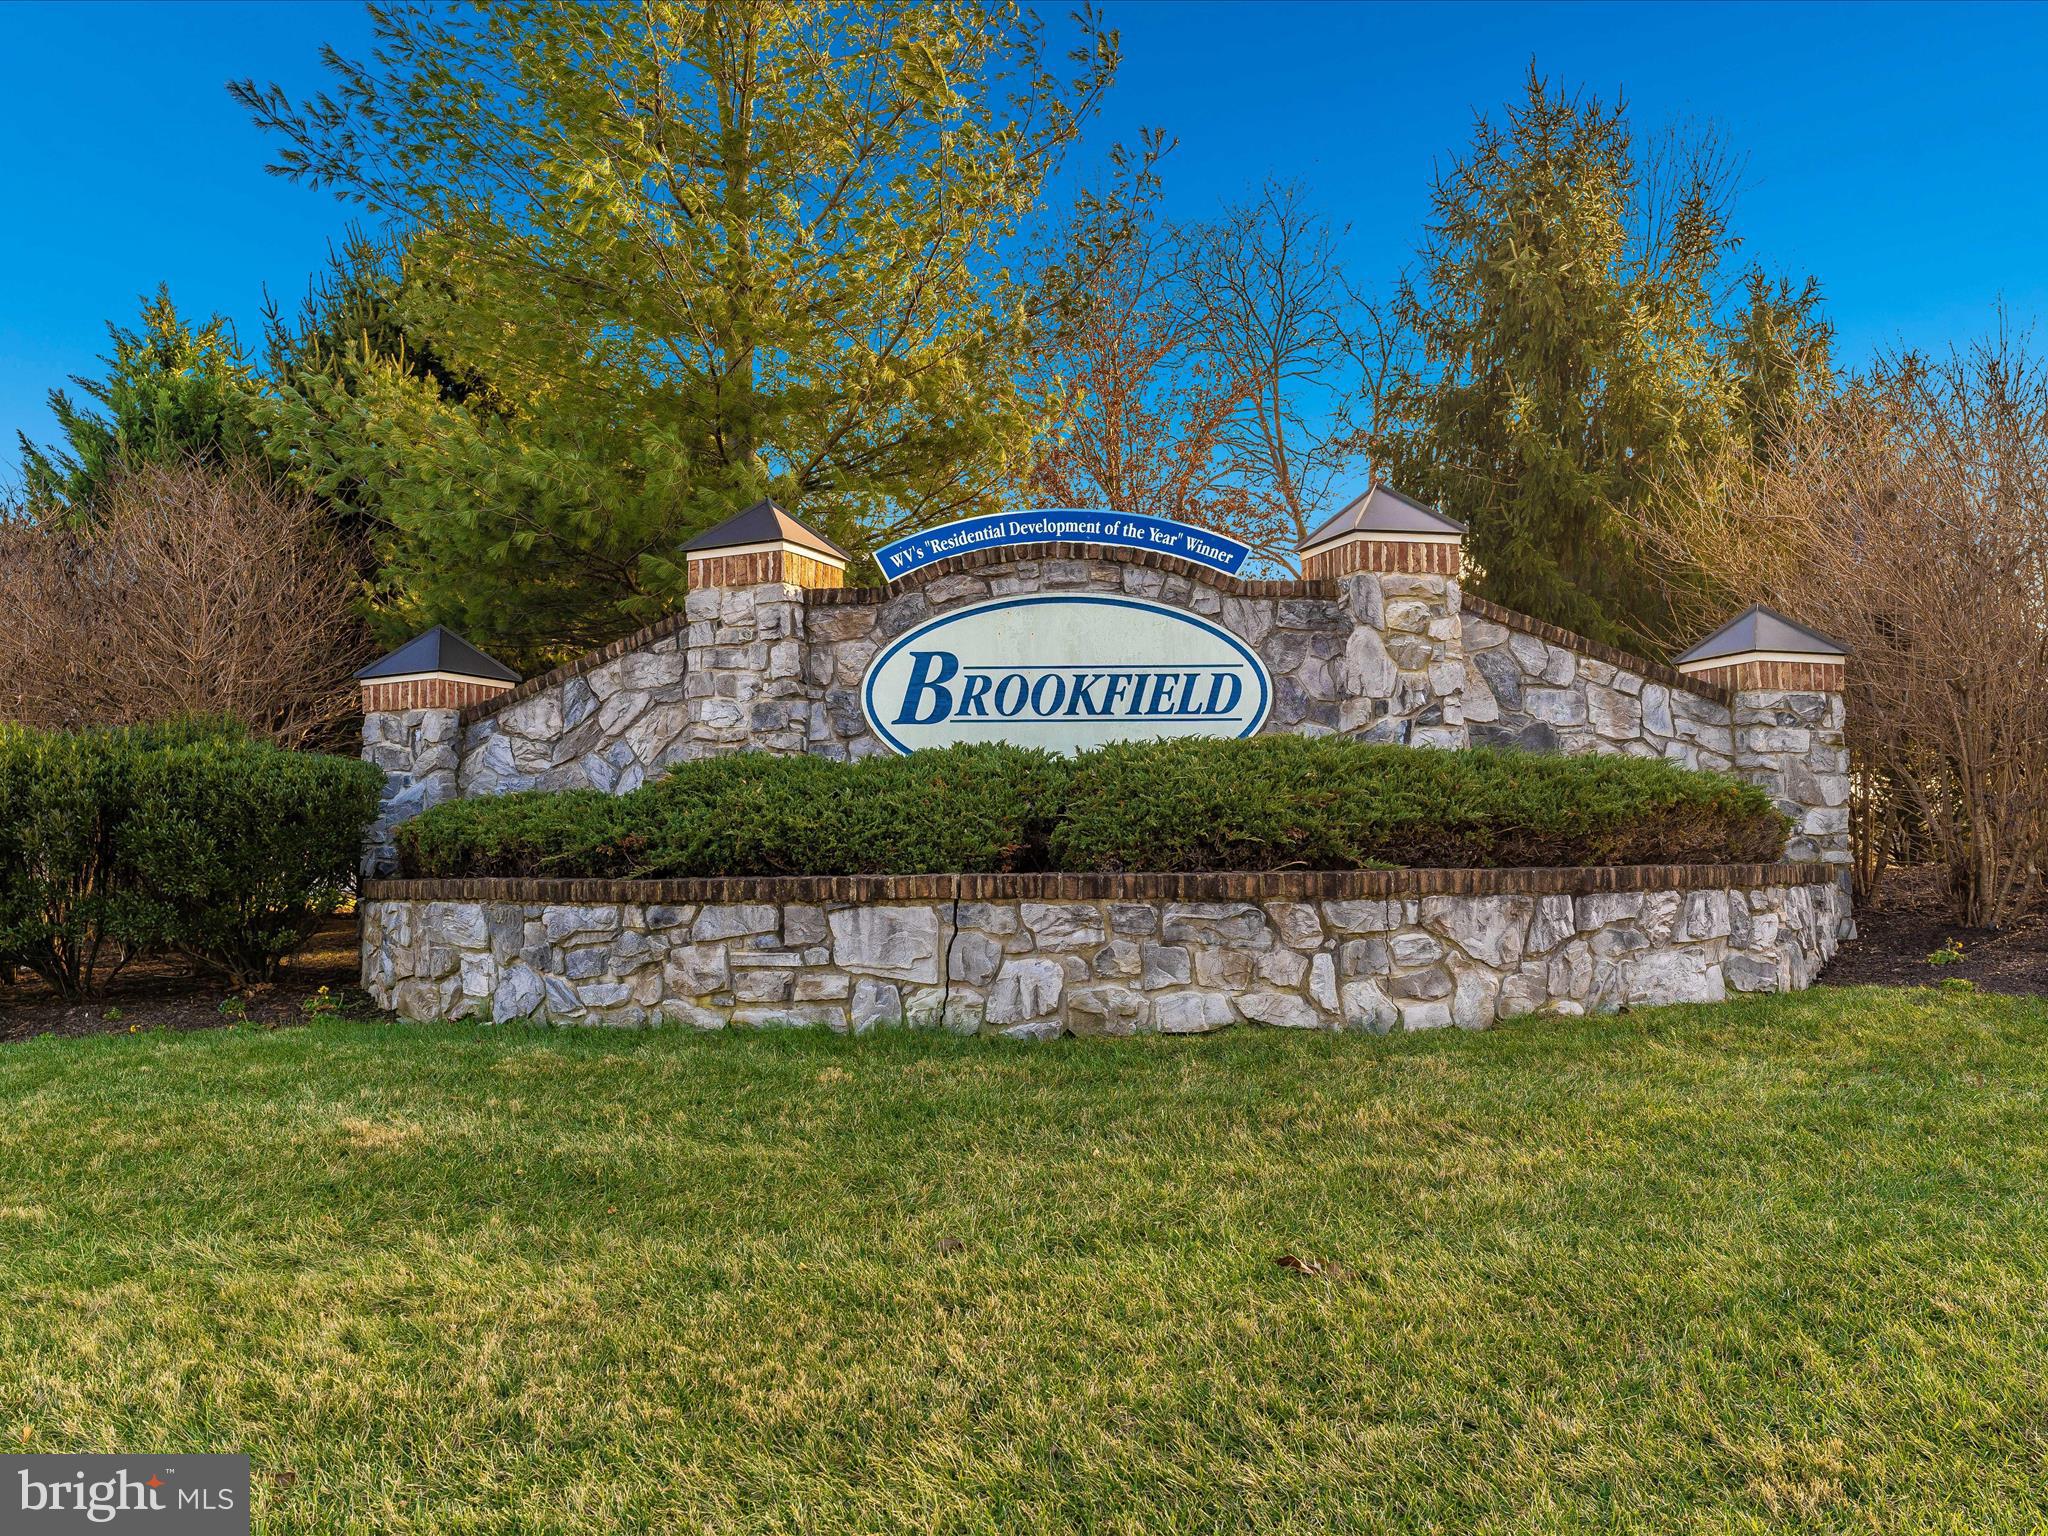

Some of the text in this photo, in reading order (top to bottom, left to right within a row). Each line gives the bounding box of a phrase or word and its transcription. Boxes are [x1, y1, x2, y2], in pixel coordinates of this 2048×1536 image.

[889, 518, 1234, 568] WV's "Residential Development of the Year" Winner
[891, 651, 1243, 725] BROOKFIELD
